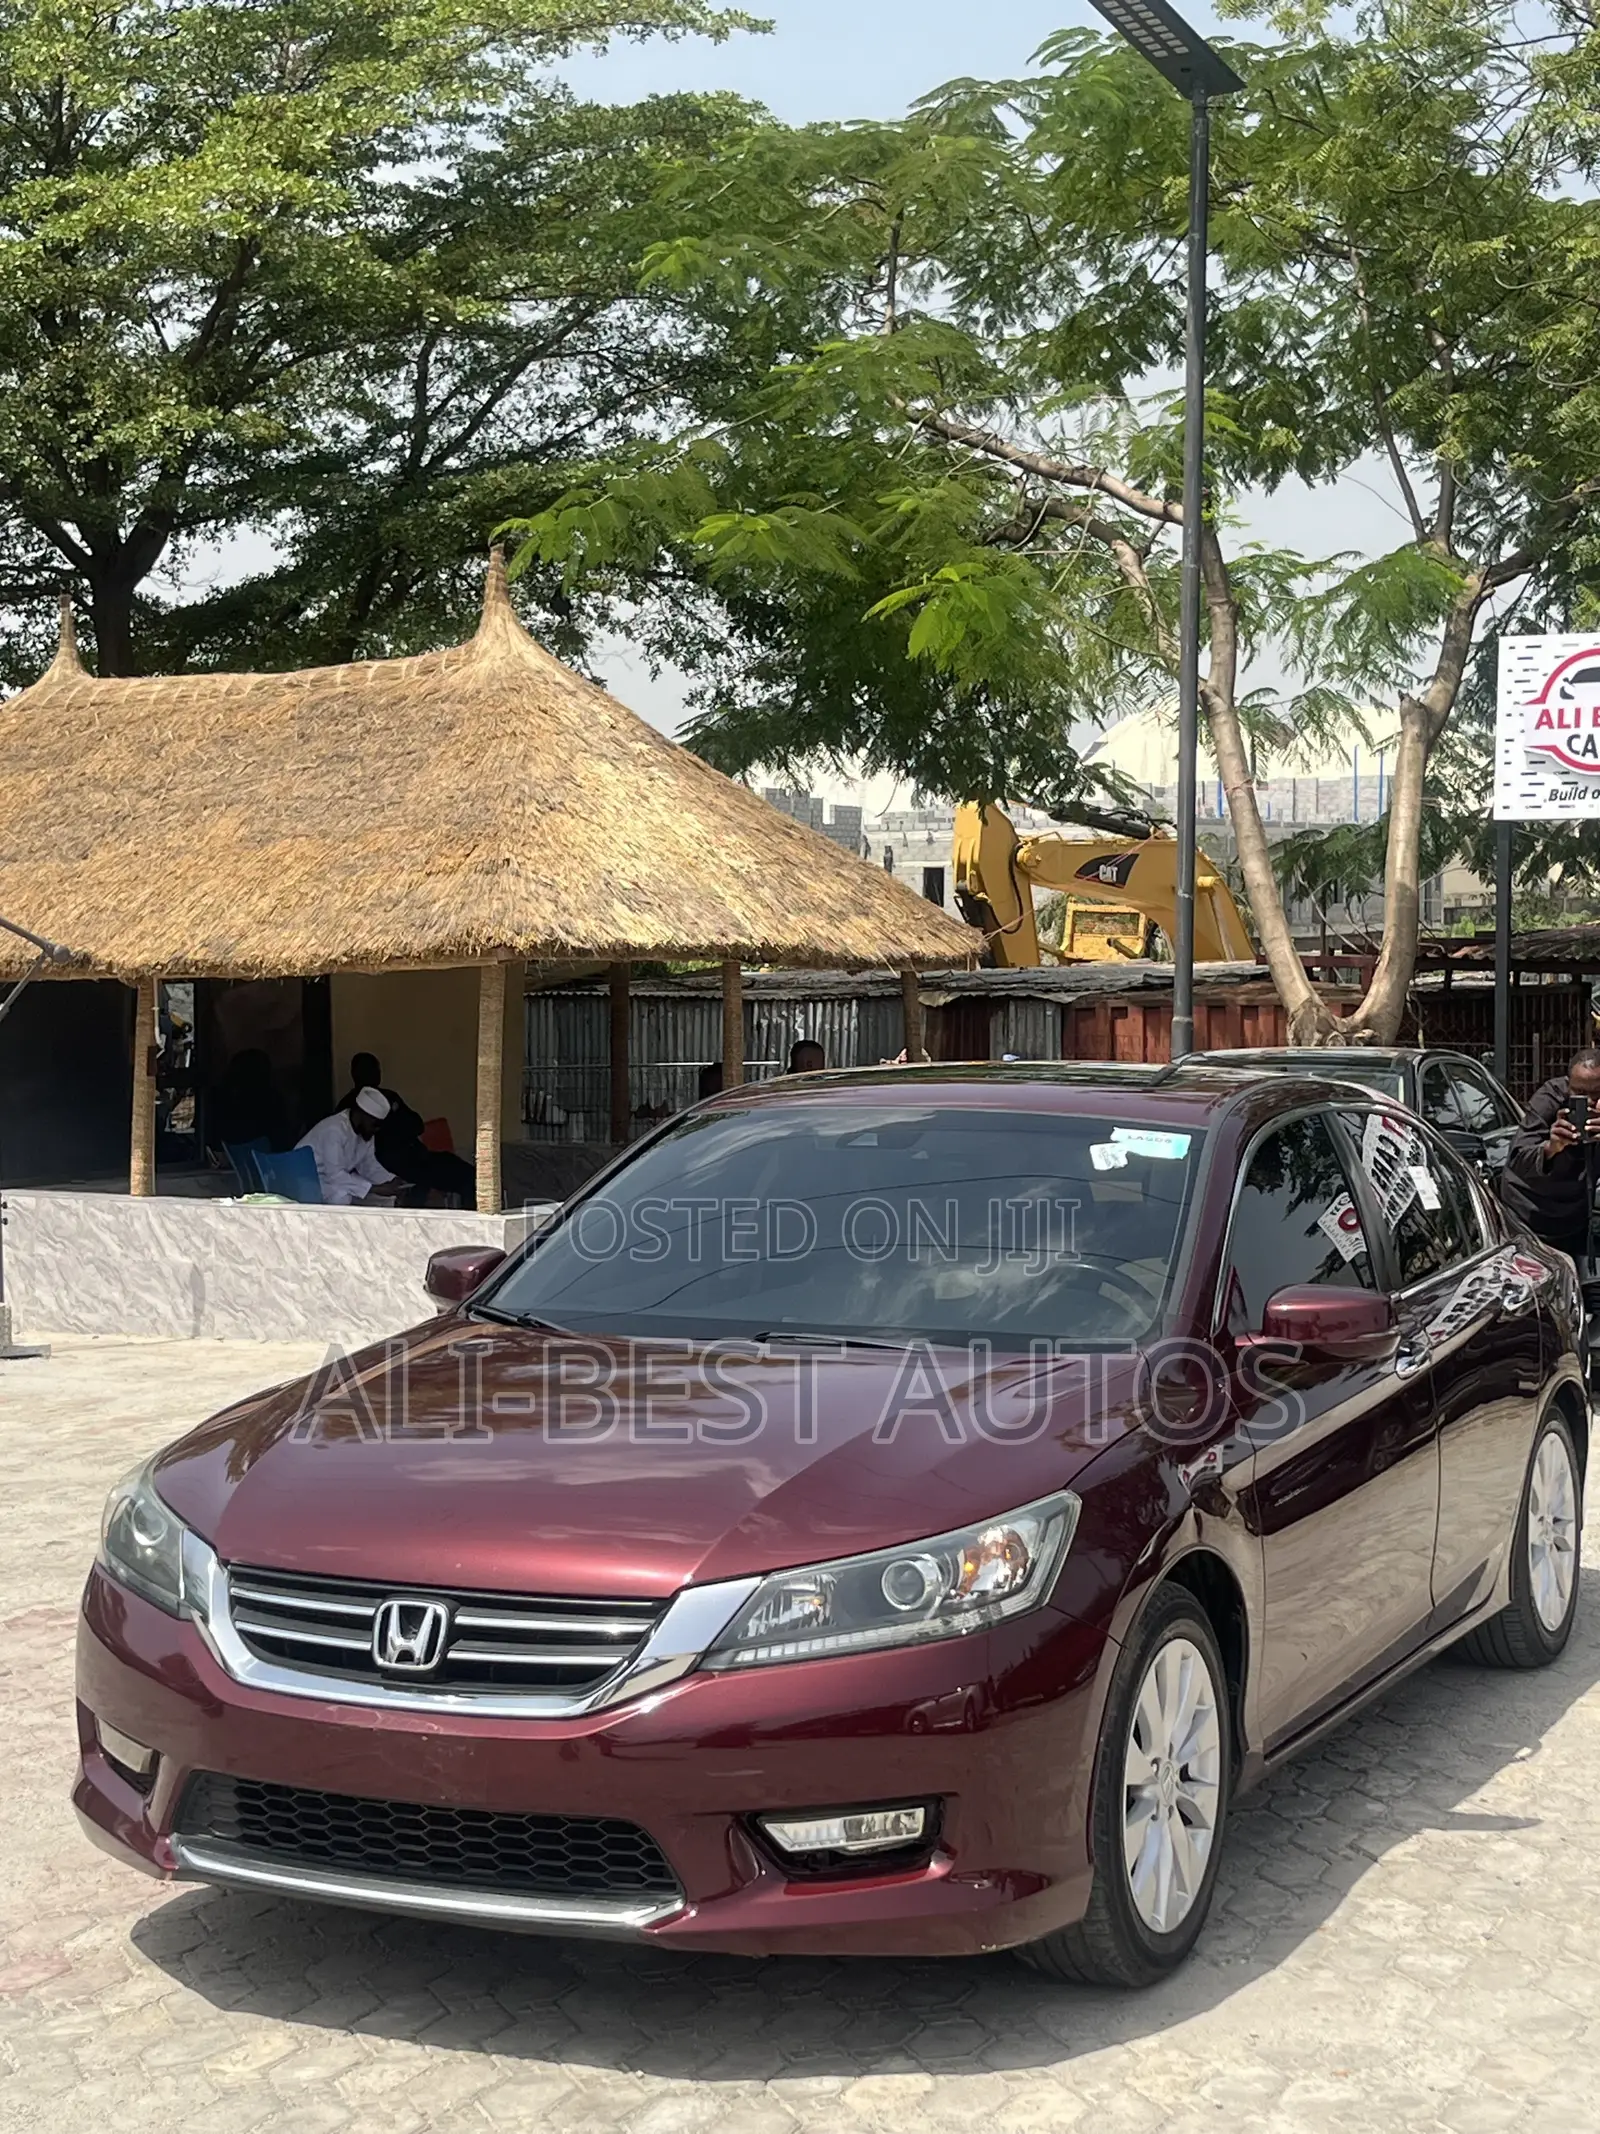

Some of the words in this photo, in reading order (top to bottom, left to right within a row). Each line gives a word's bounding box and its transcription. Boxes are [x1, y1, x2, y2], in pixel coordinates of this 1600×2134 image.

[1535, 708, 1581, 729] ALI
[1548, 786, 1588, 801] Build
[1099, 864, 1118, 883] CAT
